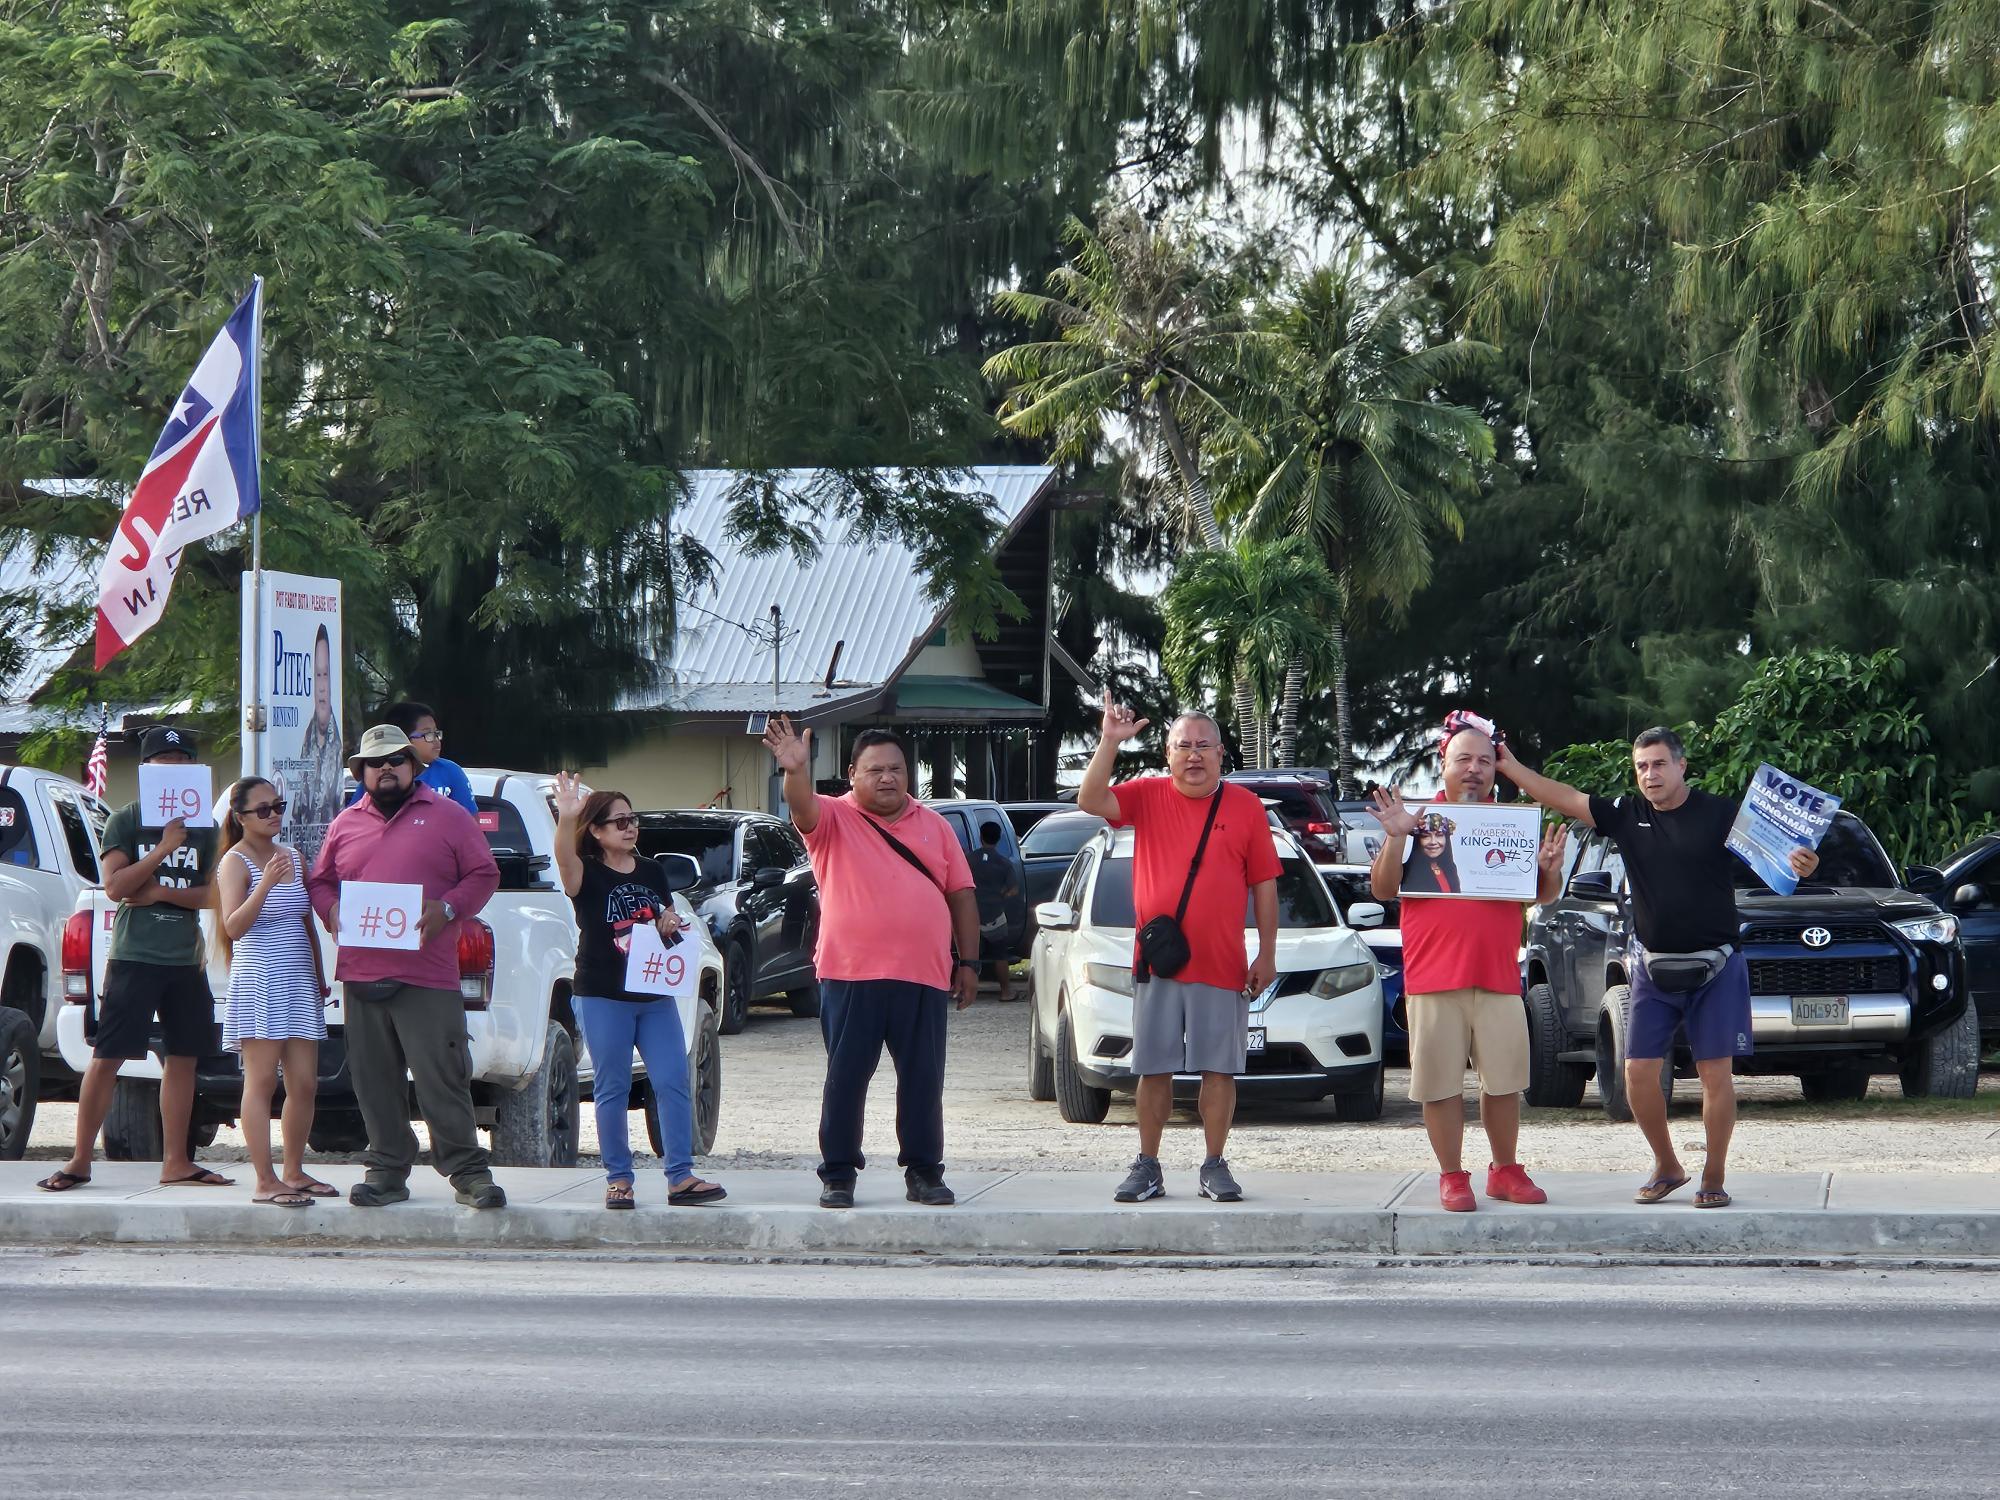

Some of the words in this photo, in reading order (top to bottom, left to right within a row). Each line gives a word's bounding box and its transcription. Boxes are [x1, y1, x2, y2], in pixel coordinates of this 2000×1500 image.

[273, 630, 312, 697] PITEG
[158, 788, 201, 818] #9
[1751, 781, 1779, 803] ELIAS
[1766, 771, 1825, 813] VOTE
[1752, 794, 1814, 836] RANGAMAR
[1460, 836, 1535, 848] KING-HINDS
[1471, 828, 1525, 837] KIMBERLYN
[1504, 849, 1534, 873] #3
[359, 906, 407, 939] #9
[642, 952, 686, 987] #9
[1825, 1003, 1846, 1018] 937
[1248, 1034, 1264, 1049] 22
